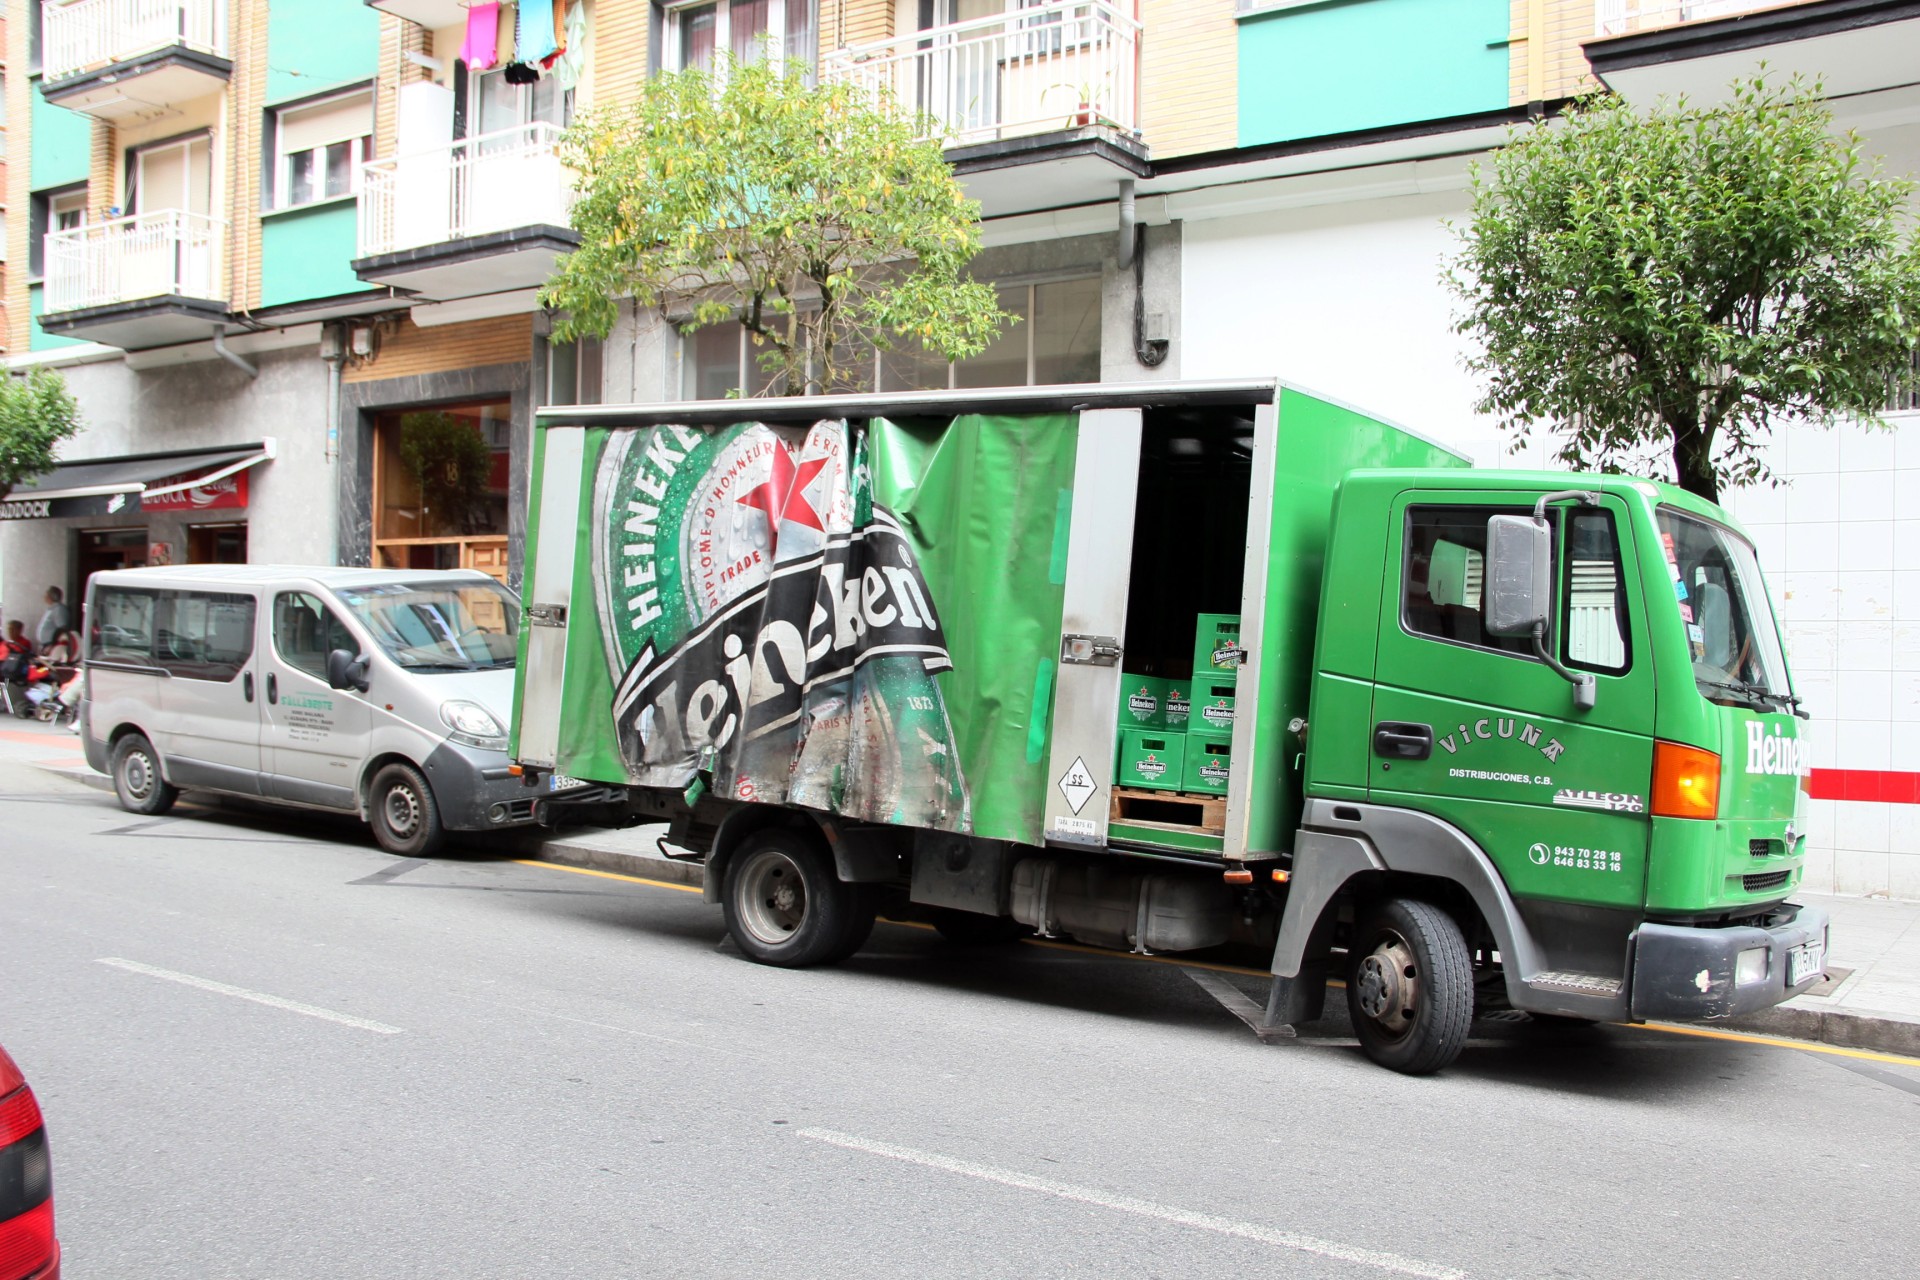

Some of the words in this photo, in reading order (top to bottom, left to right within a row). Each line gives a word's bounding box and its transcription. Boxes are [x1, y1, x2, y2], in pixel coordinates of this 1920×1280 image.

[704, 441, 773, 518] D'HONNEUR
[699, 528, 719, 609] DIPLOME
[720, 550, 762, 584] TRADE
[906, 696, 934, 710] 1873
[1071, 774, 1084, 785] SS
[1449, 768, 1532, 785] DISTRIBUCIONES,
[1534, 776, 1553, 786] C.B.
[1555, 789, 1644, 804] ATLEON
[1609, 802, 1643, 812] 120
[1554, 845, 1575, 857] 943
[1578, 848, 1590, 858] 70
[1593, 849, 1607, 860] 28
[1609, 851, 1621, 861] 18
[1553, 856, 1574, 867] 646
[1576, 858, 1590, 868] 83
[1592, 860, 1606, 870] 33
[1609, 862, 1621, 872] 16
